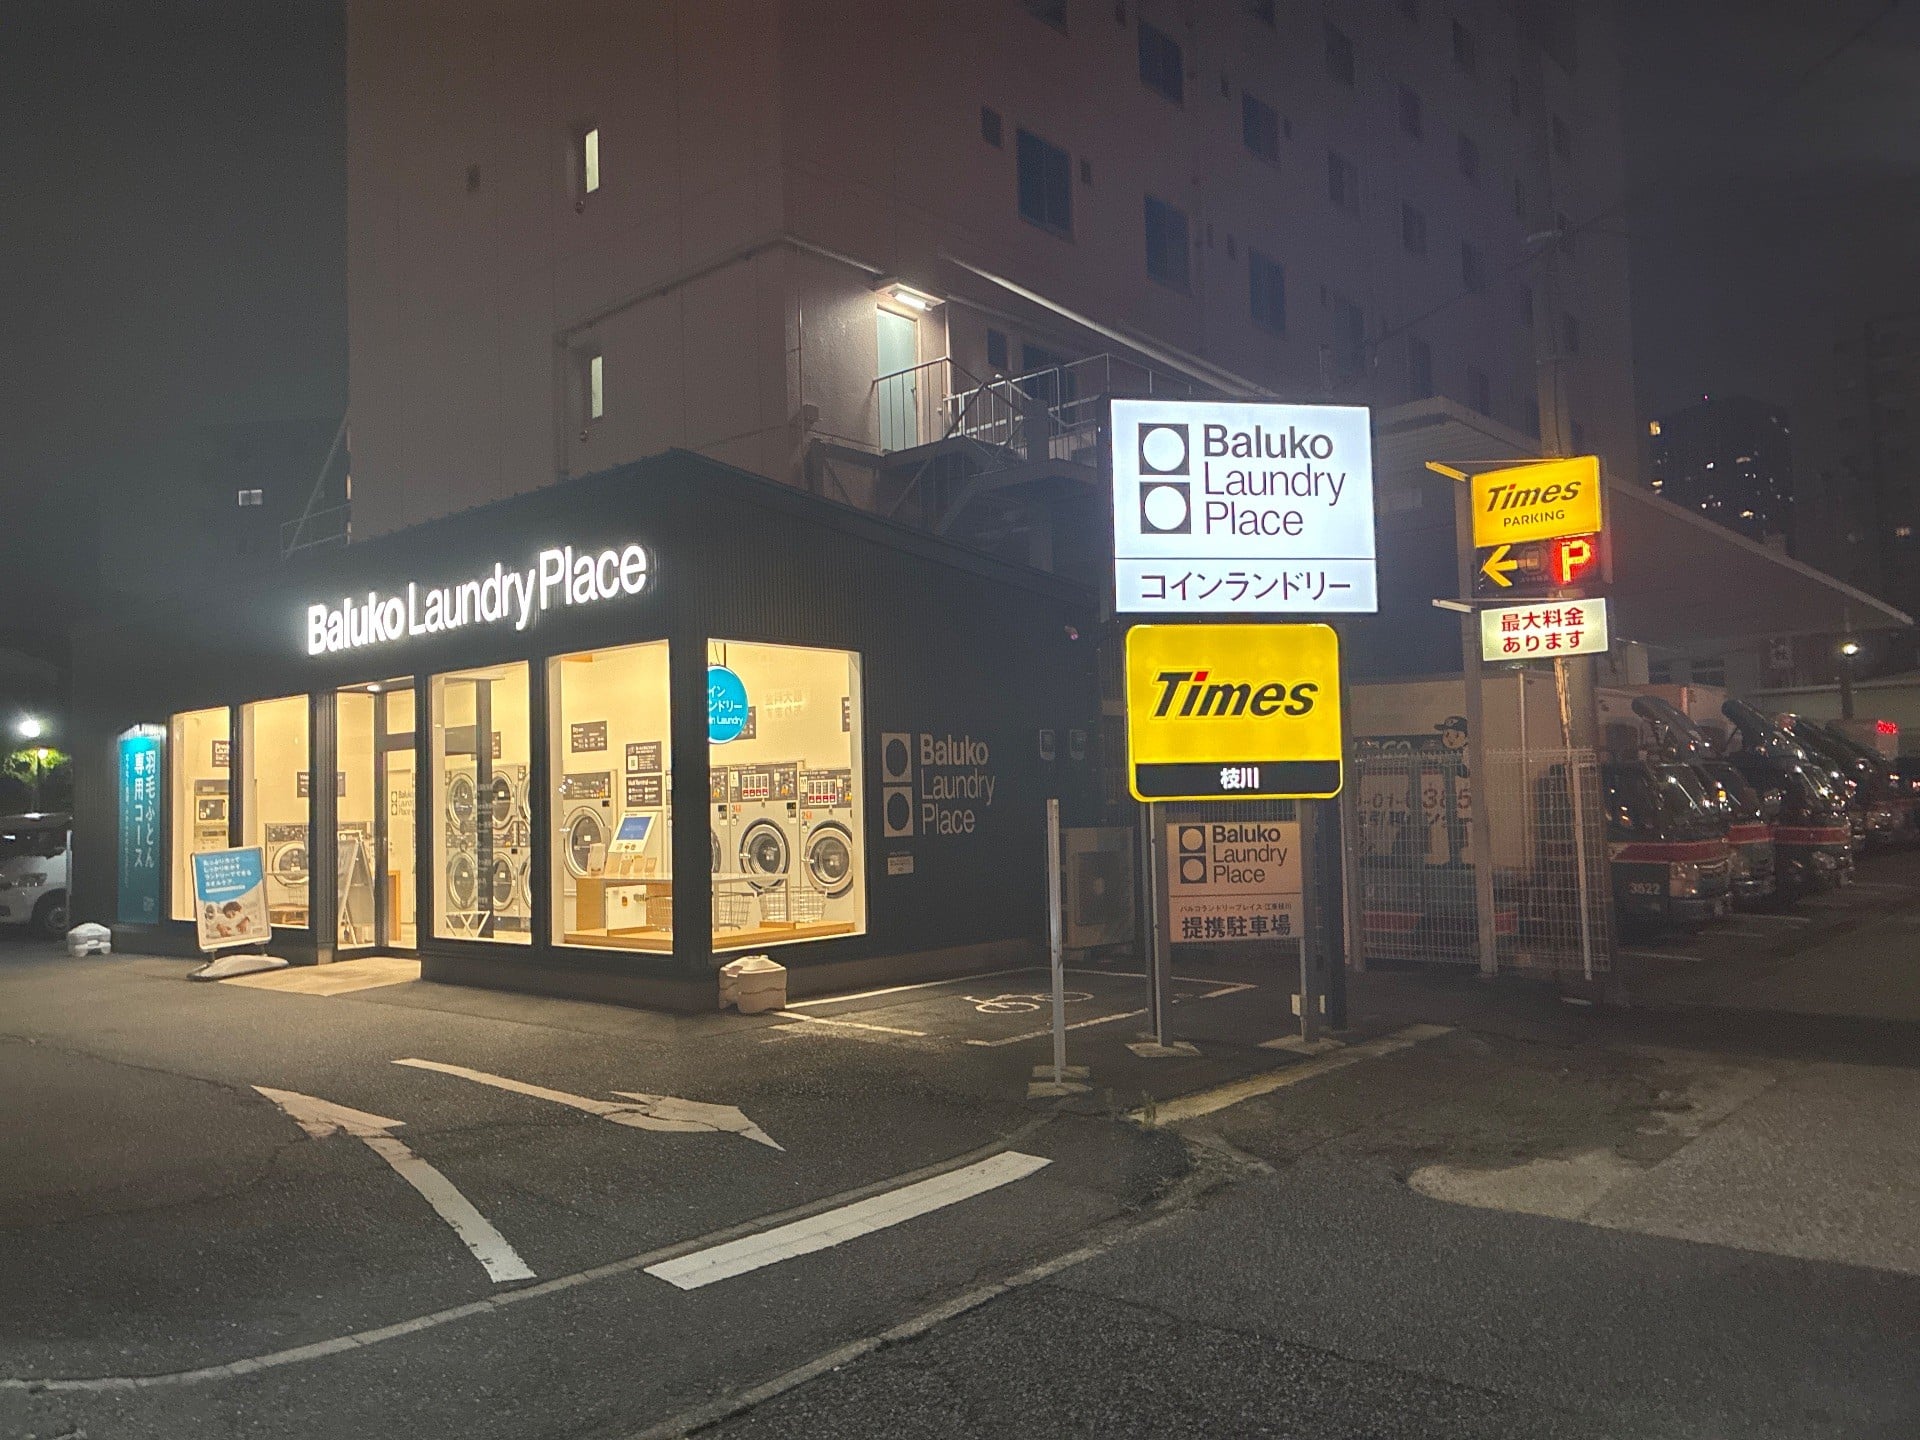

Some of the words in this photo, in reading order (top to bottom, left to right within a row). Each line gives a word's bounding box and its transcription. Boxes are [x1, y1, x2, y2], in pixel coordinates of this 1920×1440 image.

[1203, 423, 1333, 459] Baluko
[1204, 461, 1346, 506] Laundry
[1487, 481, 1582, 513] Times
[1205, 501, 1304, 536] Place
[1503, 509, 1566, 528] PARKING
[1561, 539, 1592, 584] P
[307, 591, 405, 656] Baluko
[407, 562, 536, 636] Laundry
[539, 543, 647, 610] Place
[1141, 571, 1351, 602] コインランドリー
[1501, 606, 1585, 632] 最大料金
[1502, 630, 1585, 654] あります
[1154, 671, 1319, 717] Times
[919, 733, 989, 766] Baluko
[920, 768, 996, 807] Laundry
[1220, 766, 1260, 790] 枝川
[134, 752, 144, 868] 専用コース
[921, 803, 976, 836] Place
[1212, 825, 1281, 844] Baluko
[1213, 843, 1288, 867] Laundry
[1213, 865, 1266, 883] Place
[1181, 914, 1292, 940] 提携駐車場
